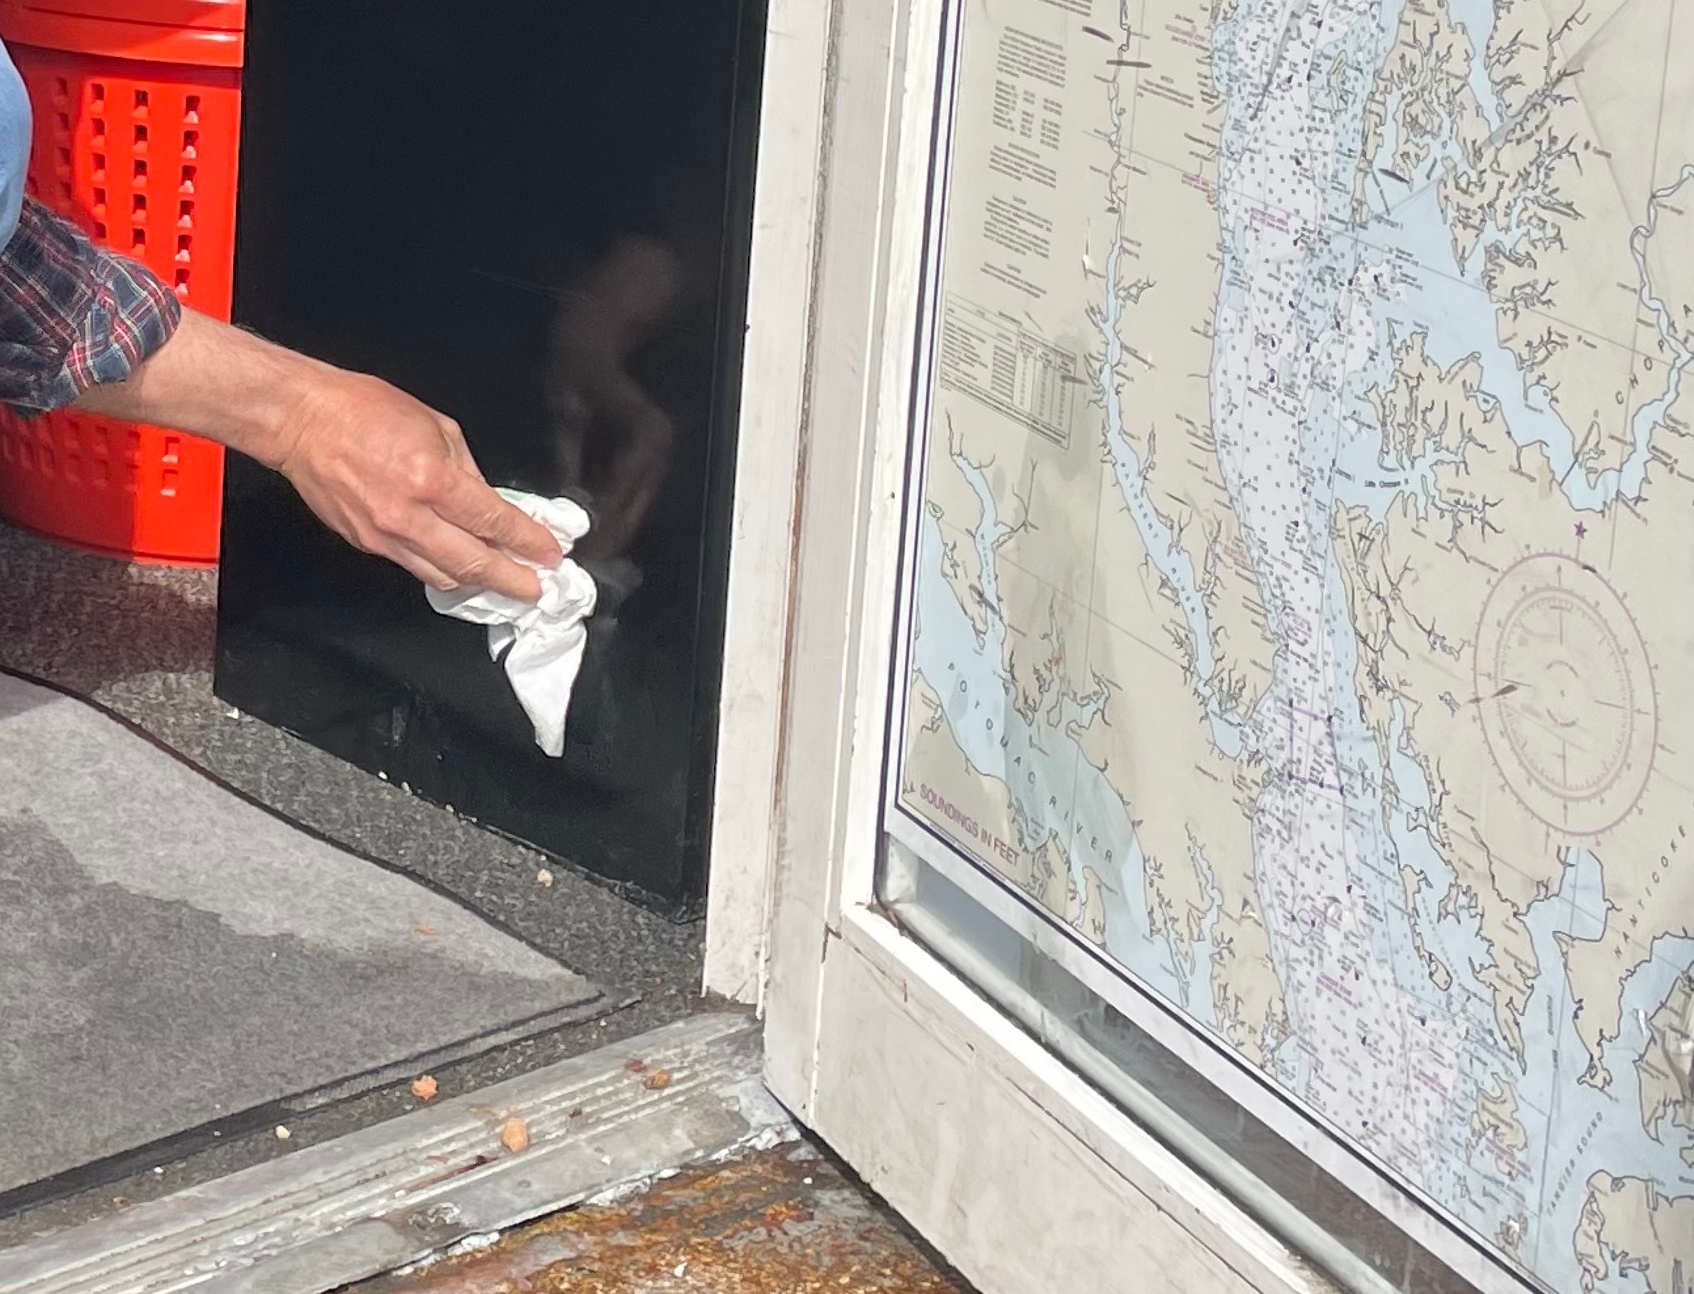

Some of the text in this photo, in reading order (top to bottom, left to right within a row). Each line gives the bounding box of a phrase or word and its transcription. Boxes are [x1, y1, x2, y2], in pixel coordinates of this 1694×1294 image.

[920, 783, 979, 838] SOUNDINGS
[981, 828, 992, 847] IN
[994, 837, 1020, 866] FEET
[1049, 796, 1113, 863] RIVER
